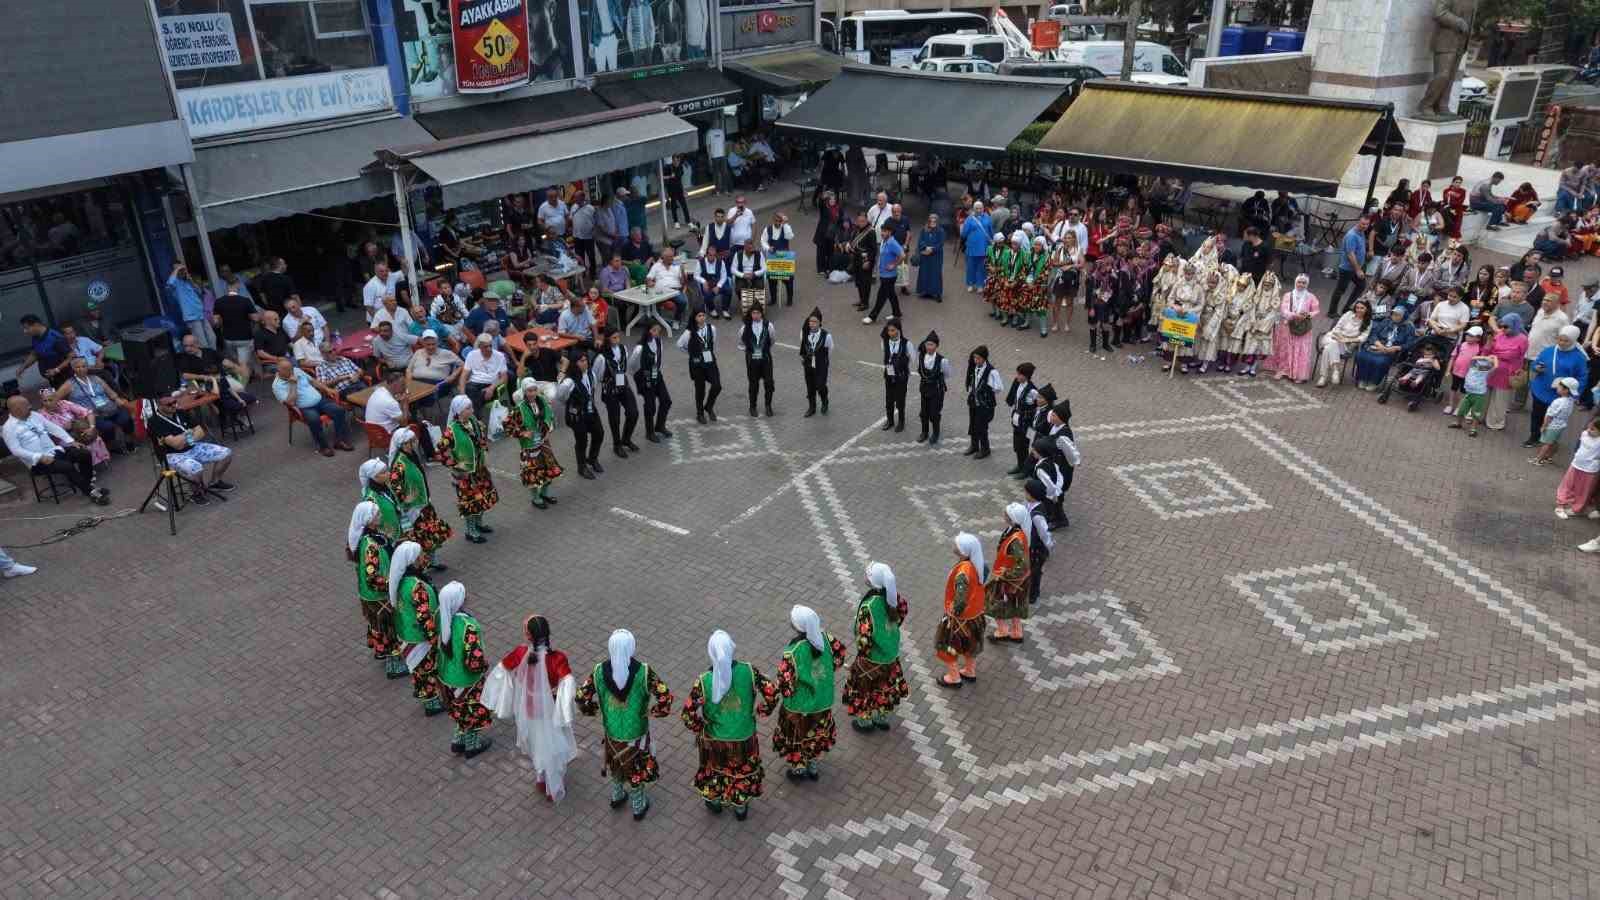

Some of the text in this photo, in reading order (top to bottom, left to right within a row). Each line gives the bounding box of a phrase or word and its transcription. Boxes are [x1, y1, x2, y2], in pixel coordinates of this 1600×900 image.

[174, 22, 186, 34] 80
[188, 19, 214, 33] NOLU
[201, 34, 231, 48] PERSONEL
[483, 34, 505, 58] 50
[186, 88, 285, 127] KARDEŞLER
[285, 85, 317, 117] ÇAY
[319, 80, 344, 107] EVİ
[678, 101, 701, 113] SPOR
